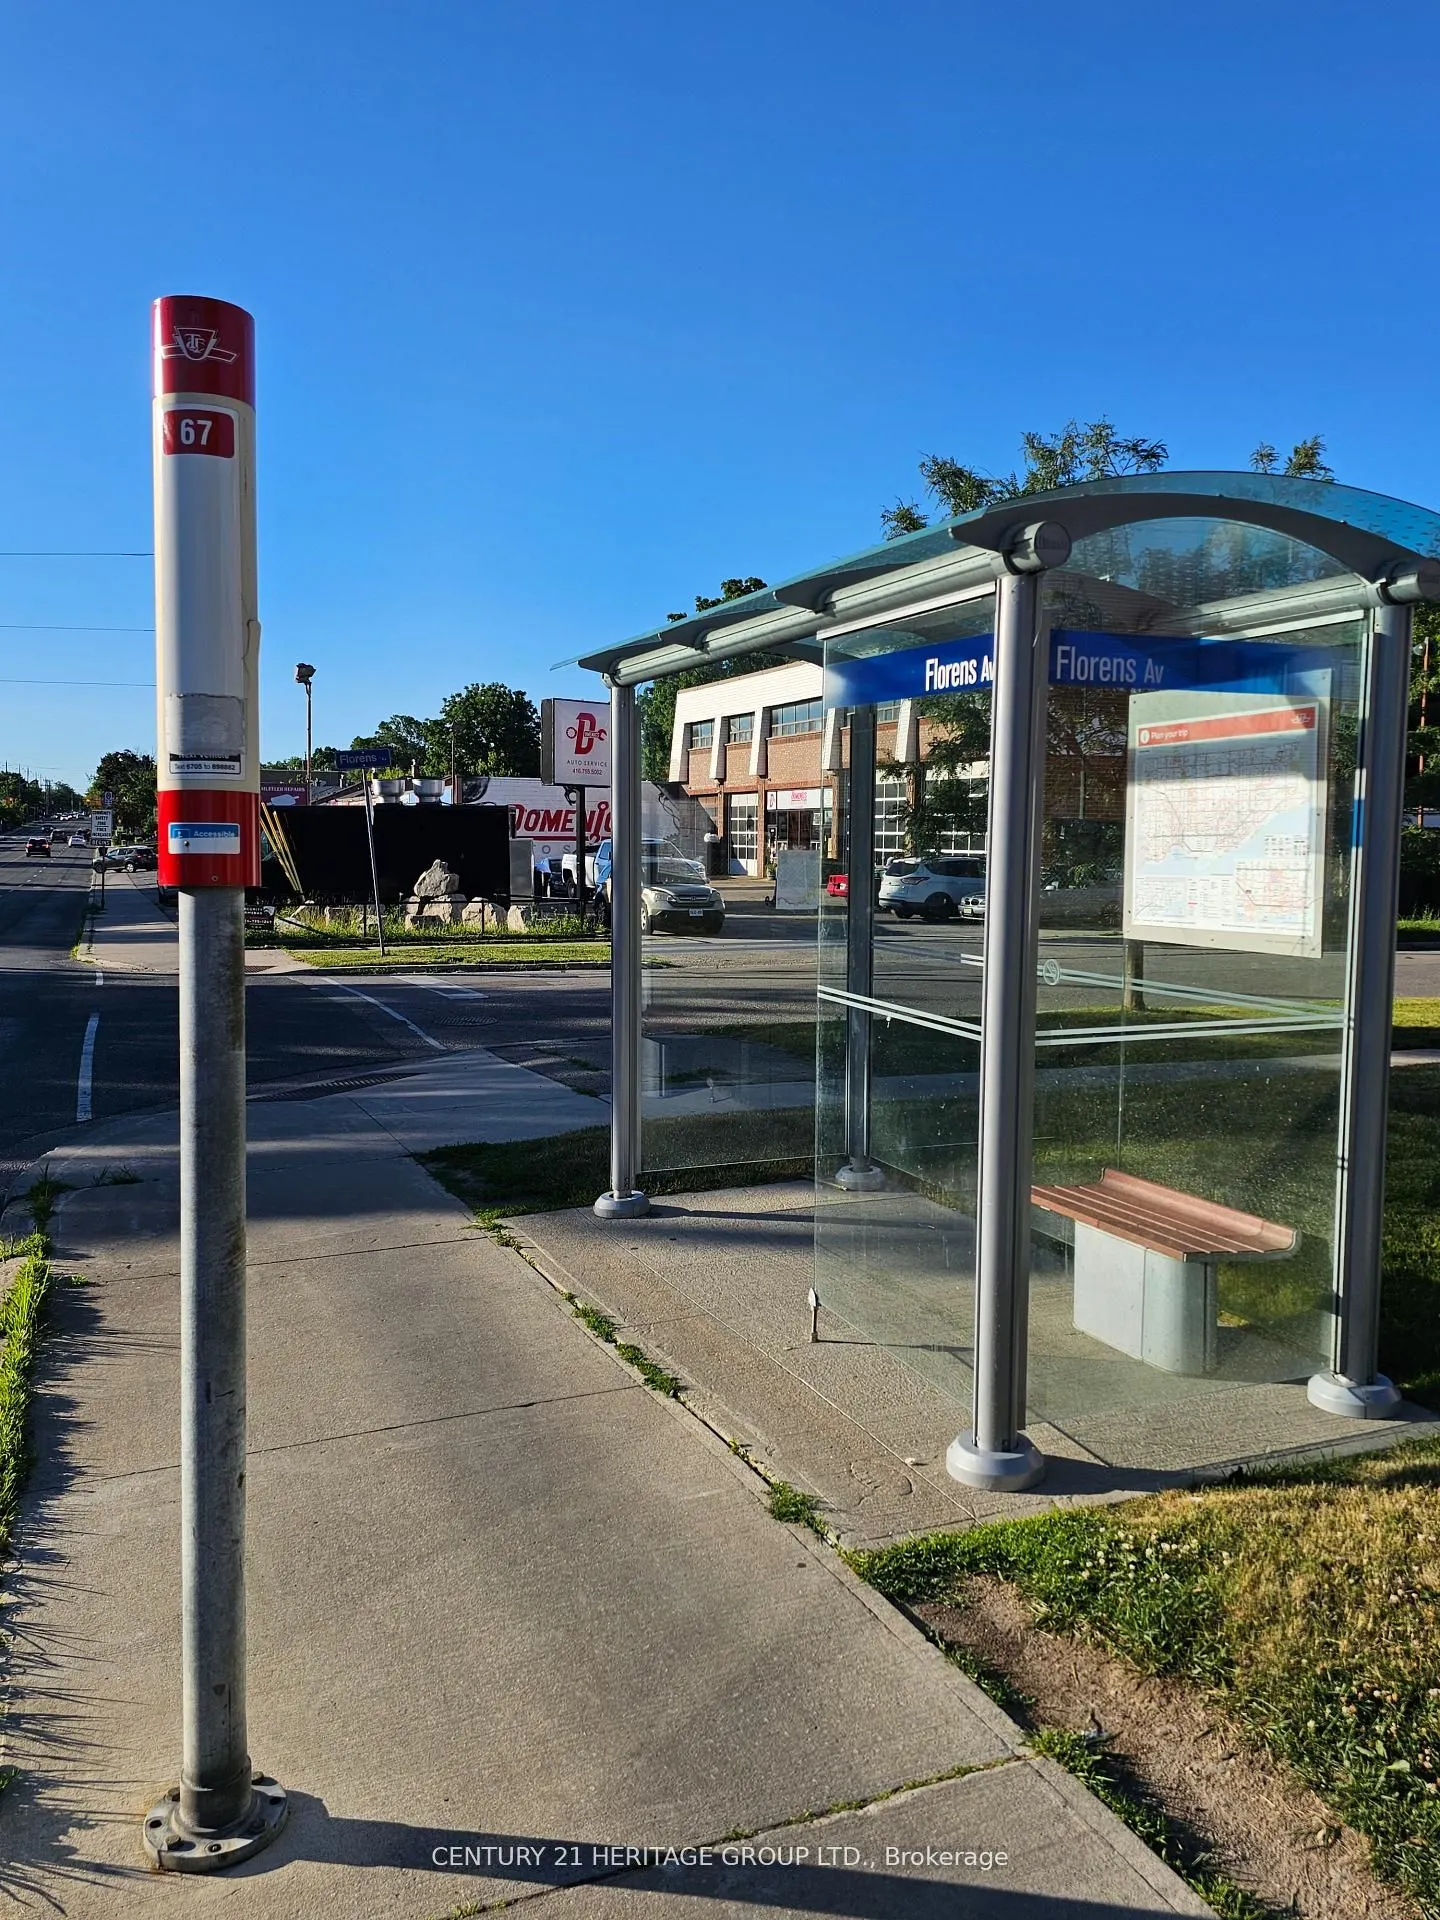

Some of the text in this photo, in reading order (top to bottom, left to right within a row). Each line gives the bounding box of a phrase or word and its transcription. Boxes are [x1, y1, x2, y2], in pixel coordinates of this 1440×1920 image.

[180, 419, 213, 446] 67
[925, 656, 977, 692] Florens
[1056, 646, 1164, 684] Florens Av
[339, 754, 377, 765] Florens
[583, 760, 608, 768] SERVICE
[193, 830, 235, 838] Accessible
